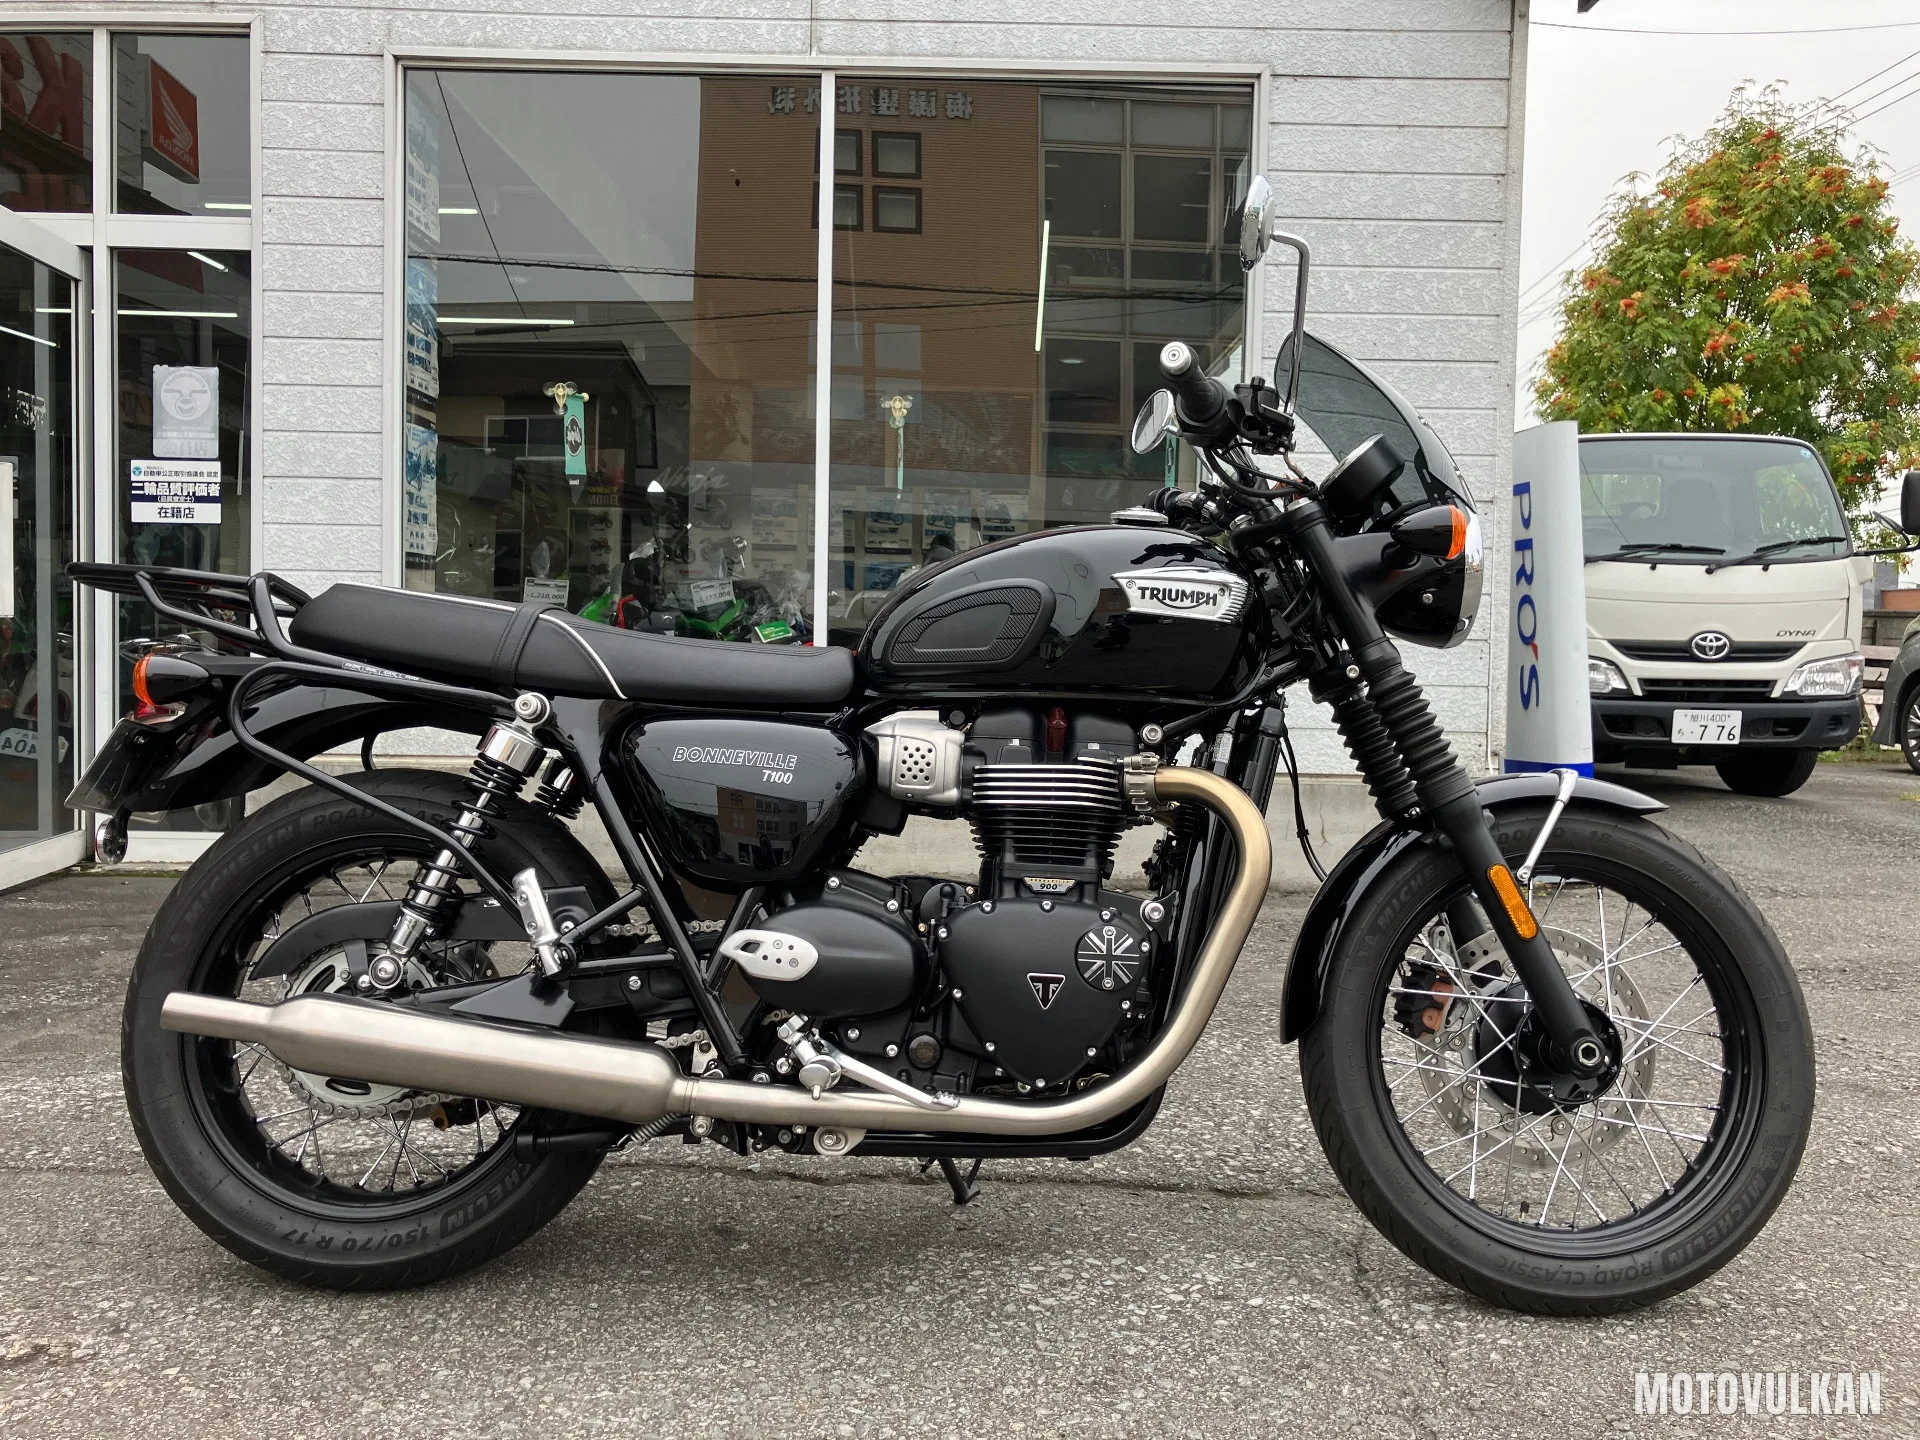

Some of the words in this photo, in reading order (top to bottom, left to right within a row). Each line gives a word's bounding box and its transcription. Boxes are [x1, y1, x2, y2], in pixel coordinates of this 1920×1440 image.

[131, 482, 220, 496] 二輪品質評価者
[157, 506, 195, 519] 在籍店
[1137, 586, 1218, 609] TRIUMPH
[672, 746, 798, 770] BONNEVILLE
[762, 769, 793, 784] T100
[313, 807, 375, 830] ROAD
[447, 1163, 531, 1232] CHELIN
[1667, 1173, 1767, 1268] MICHELIN
[280, 1228, 309, 1245] 17
[315, 1235, 335, 1250] R
[341, 1225, 431, 1251] 150/70
[1493, 1256, 1586, 1286] CLASSIC
[1593, 1260, 1654, 1286] ROAD
